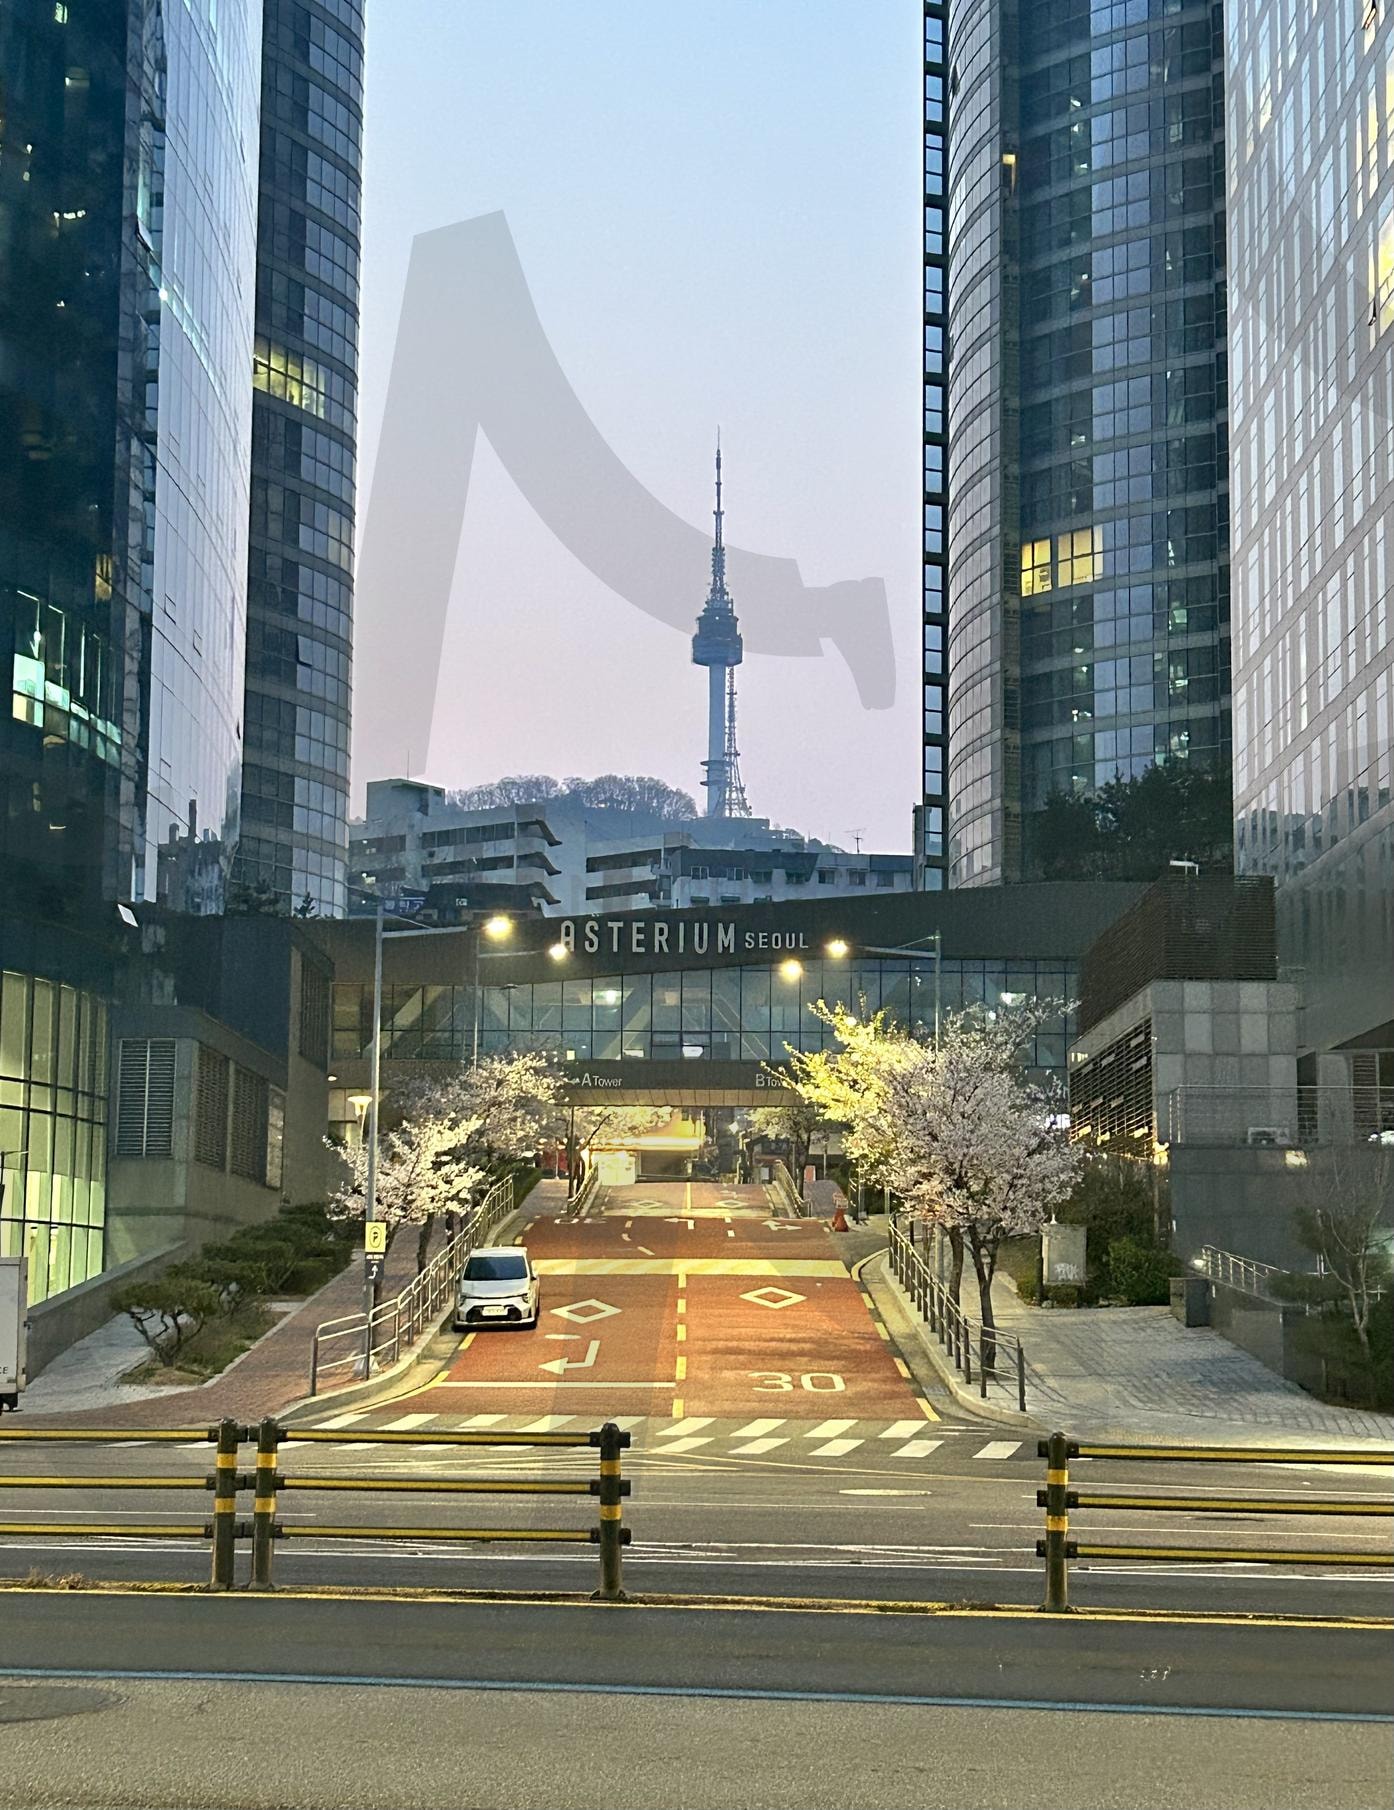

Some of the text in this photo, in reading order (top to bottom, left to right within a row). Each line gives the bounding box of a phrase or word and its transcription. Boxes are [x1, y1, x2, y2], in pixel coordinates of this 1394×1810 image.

[560, 920, 809, 954] ASTERIUM SEOUL
[581, 1072, 623, 1087] A Tower
[755, 1073, 765, 1087] B
[747, 1371, 846, 1392] 30
